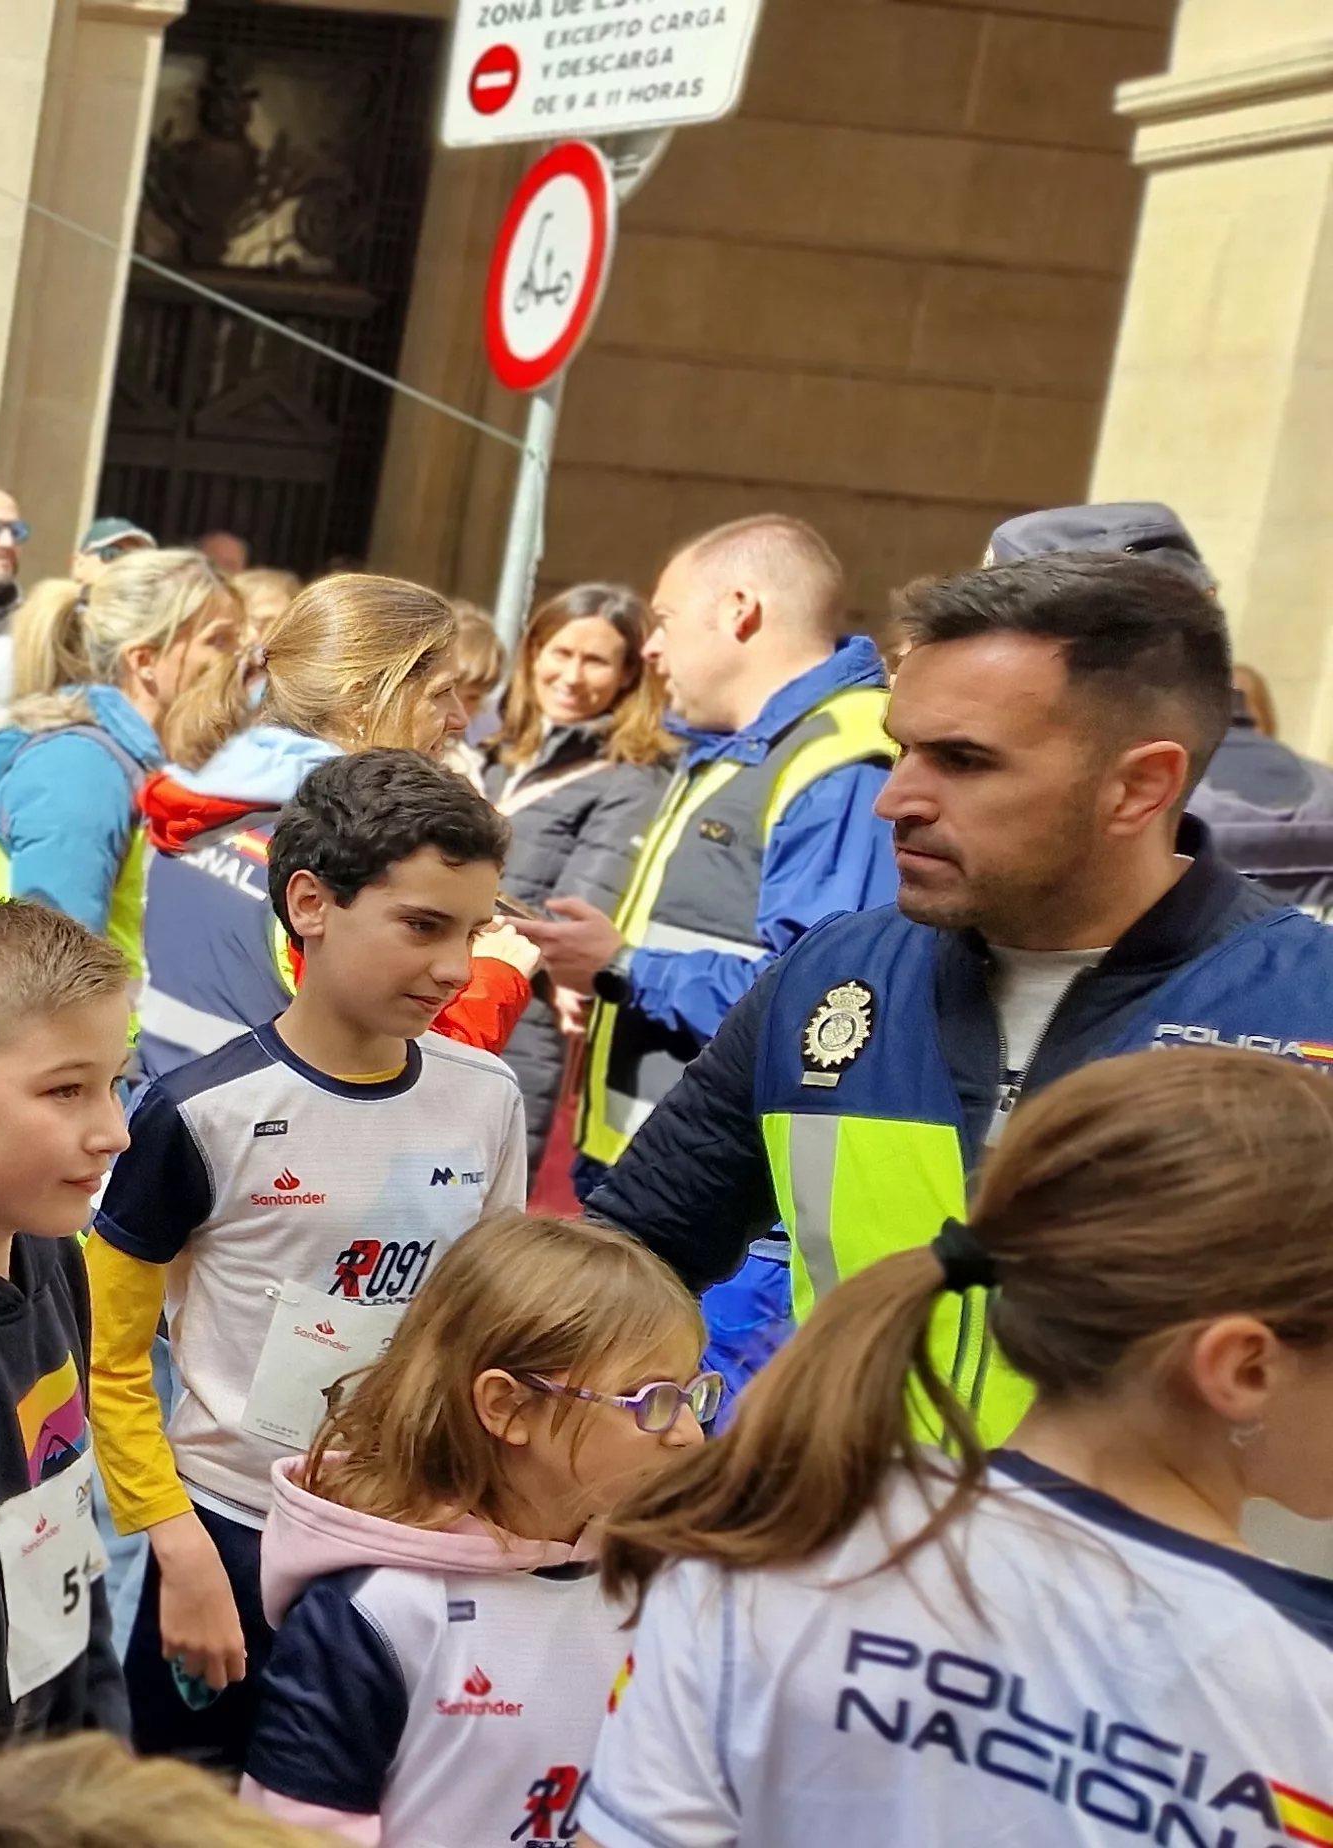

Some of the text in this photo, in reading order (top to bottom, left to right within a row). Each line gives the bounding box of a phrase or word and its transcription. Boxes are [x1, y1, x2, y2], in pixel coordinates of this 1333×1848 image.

[544, 6, 727, 50] EXCEPTO CARGA
[540, 47, 674, 80] Y DESCARGA
[532, 77, 705, 116] DE 9 A 11 HORAS
[1154, 1022, 1305, 1060] POLICIA
[255, 1121, 287, 1136] 42K
[250, 1191, 327, 1207] Santander
[293, 1324, 352, 1352] Santander
[436, 1699, 523, 1717] Santander
[844, 1629, 1281, 1832] POLICIA
[835, 1686, 1283, 1848] NACION
